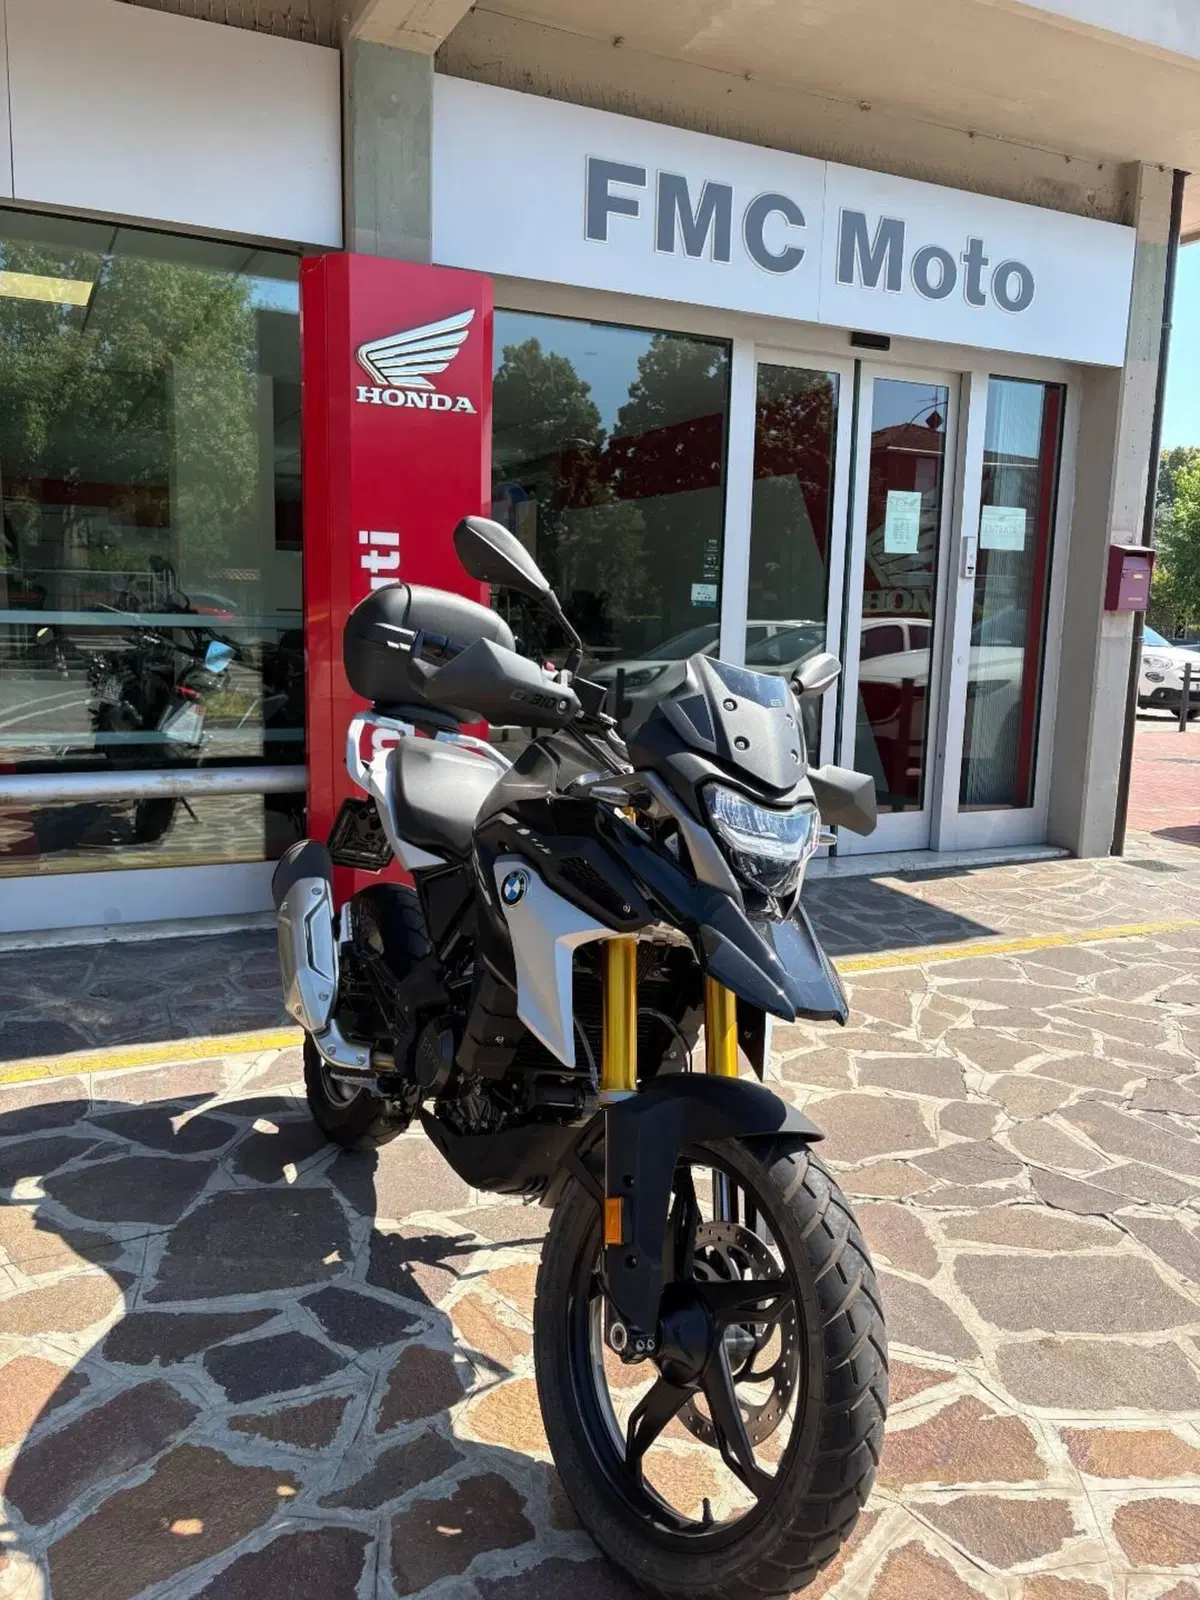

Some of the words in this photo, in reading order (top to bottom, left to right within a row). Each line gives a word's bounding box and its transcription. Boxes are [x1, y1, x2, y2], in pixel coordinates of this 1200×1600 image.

[584, 154, 807, 276] FMC
[835, 206, 1036, 314] Moto
[356, 385, 478, 414] HONDA
